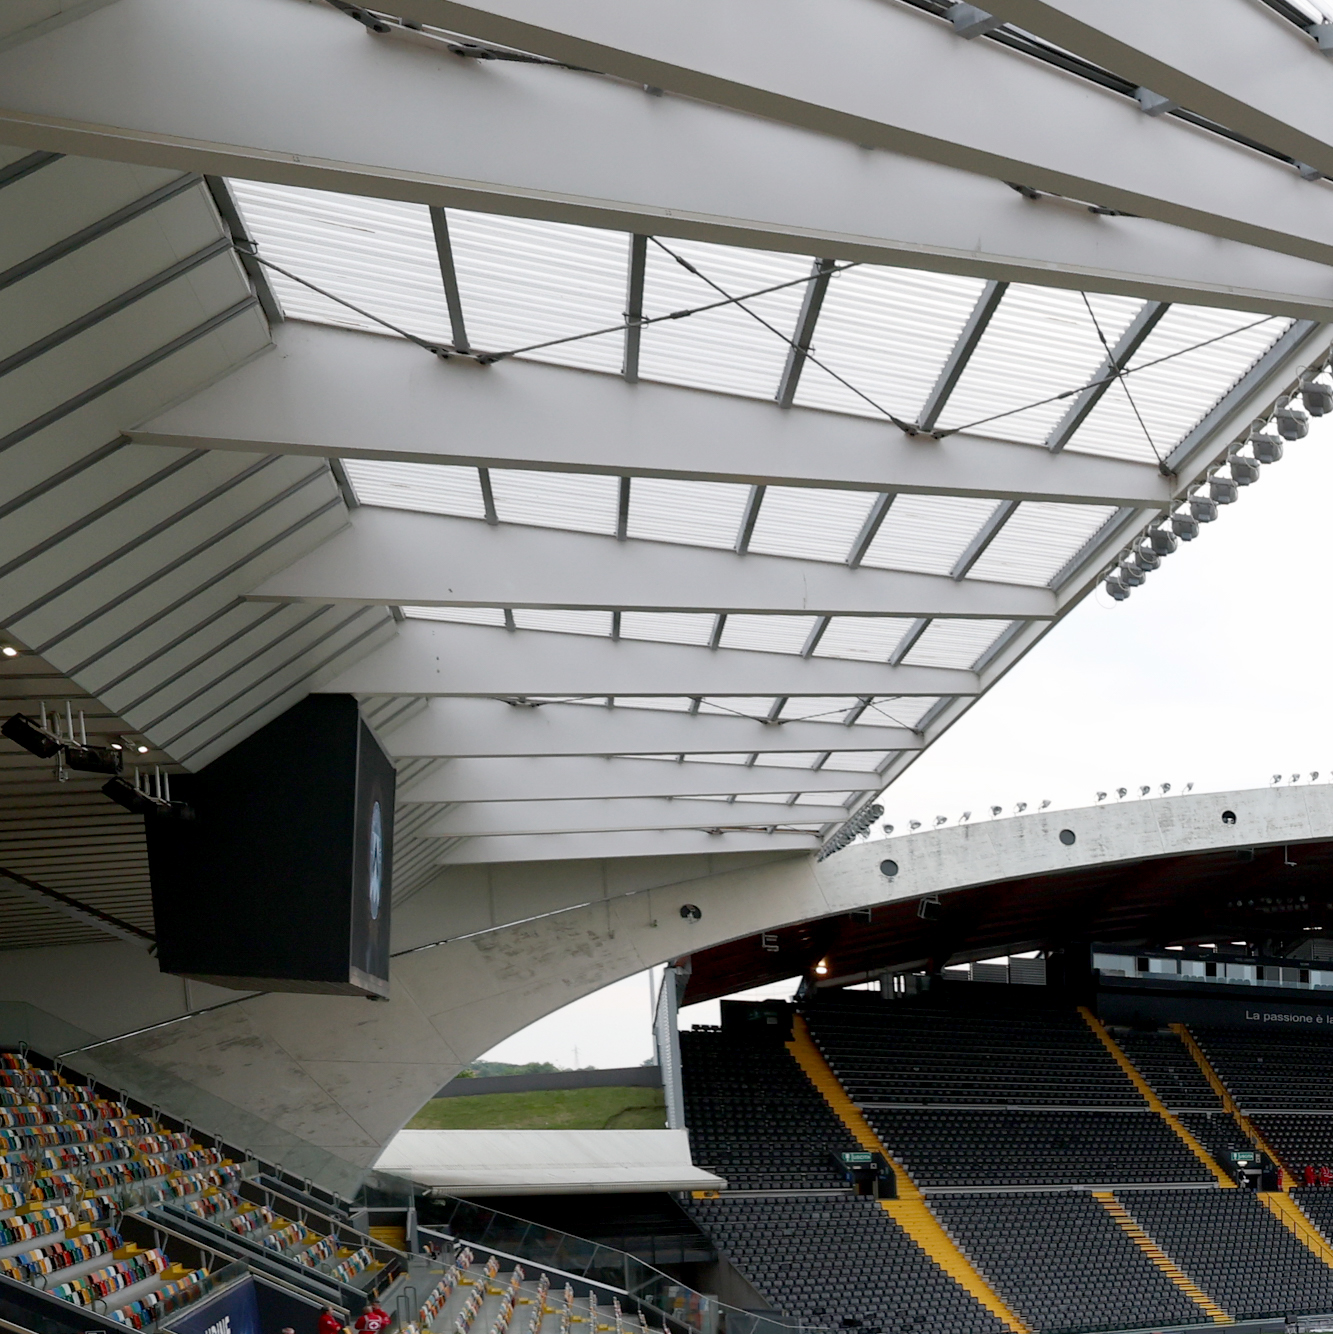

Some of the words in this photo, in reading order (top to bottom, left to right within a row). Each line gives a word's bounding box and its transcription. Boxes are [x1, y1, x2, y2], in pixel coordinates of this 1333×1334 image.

[1245, 1010, 1260, 1020] La
[1263, 1012, 1313, 1023] passione
[1316, 1014, 1323, 1023] è
